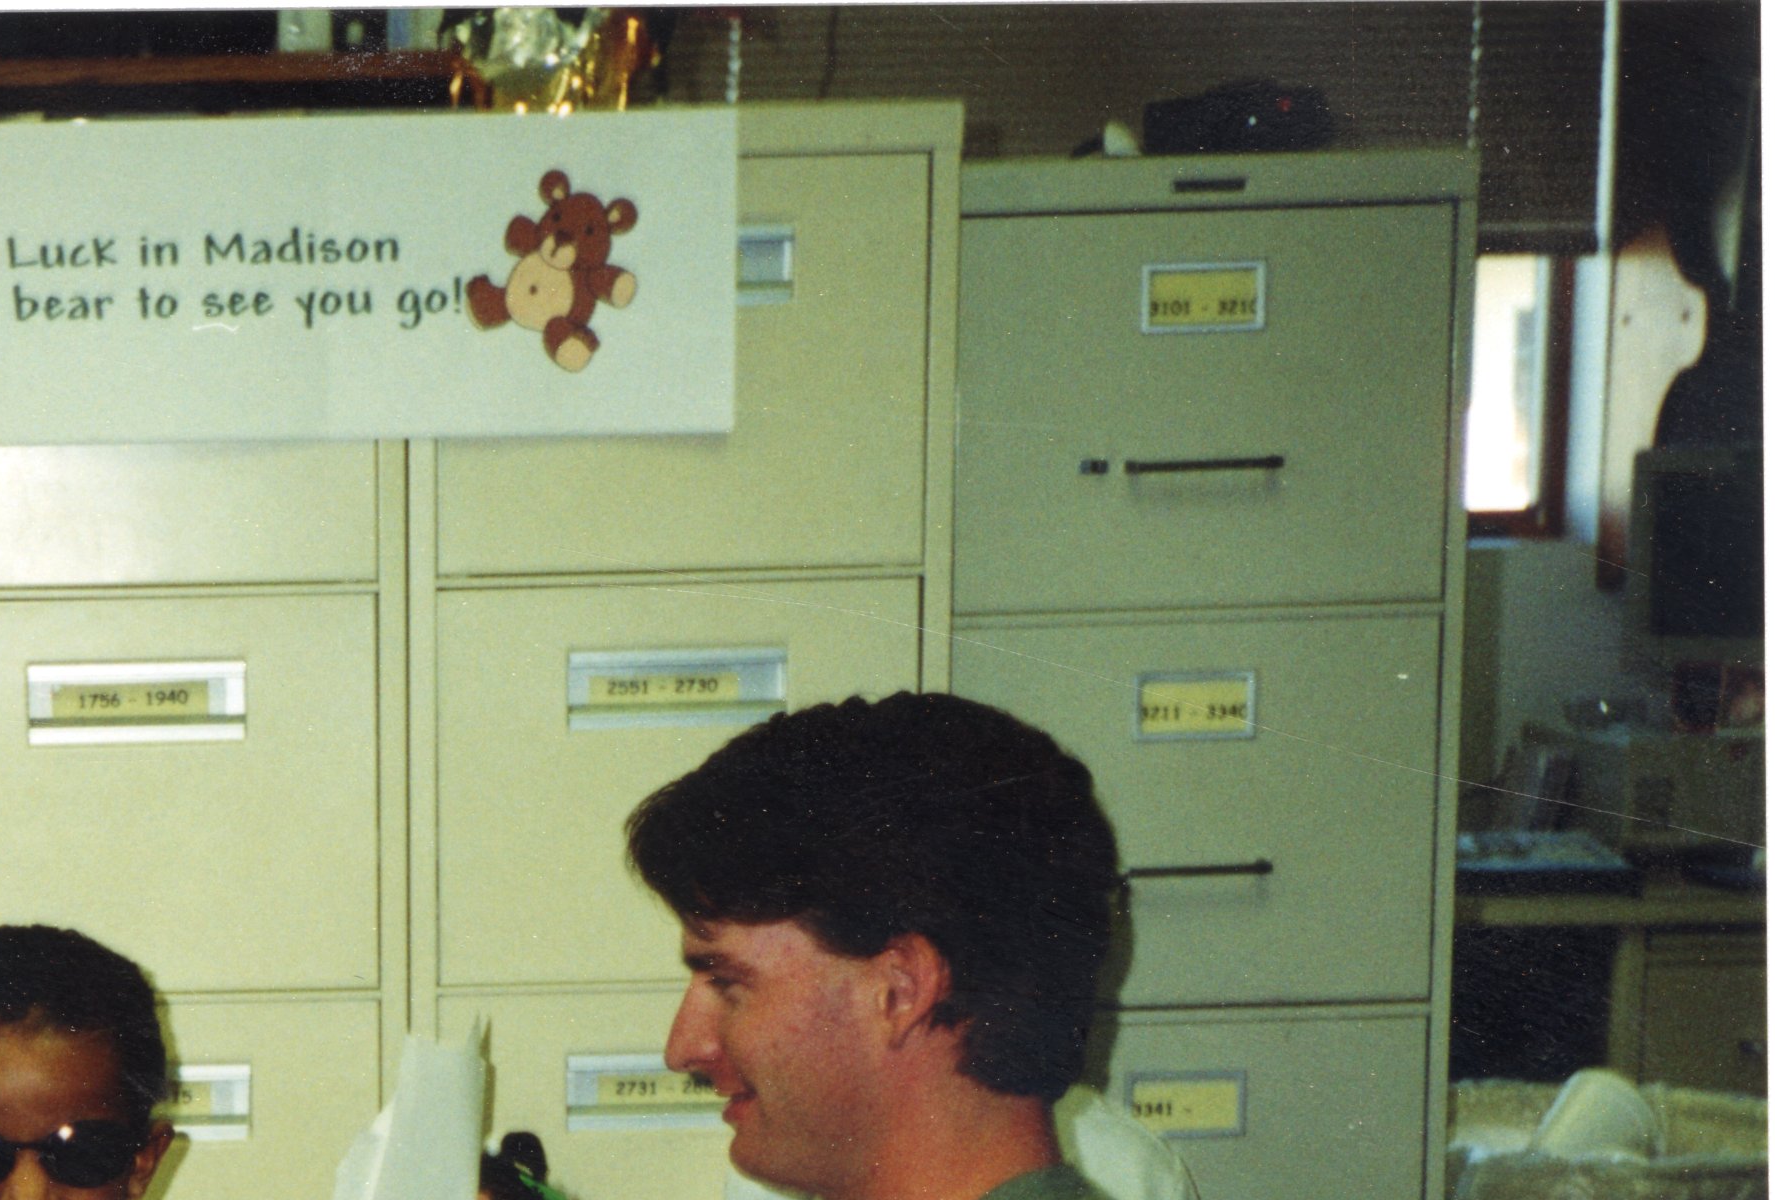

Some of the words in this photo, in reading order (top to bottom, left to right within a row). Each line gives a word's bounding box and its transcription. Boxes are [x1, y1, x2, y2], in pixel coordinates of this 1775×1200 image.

[6, 235, 118, 269] Luck
[139, 236, 180, 266] in
[203, 227, 401, 265] Madison
[13, 284, 115, 322] bear
[137, 286, 179, 319] to
[201, 291, 274, 318] see
[294, 289, 373, 329] you
[397, 275, 463, 330] go!
[608, 680, 648, 695] 2551
[675, 678, 718, 693] 2730
[78, 693, 121, 709] 1756
[146, 689, 189, 706] 1940
[616, 1081, 657, 1096] 2731
